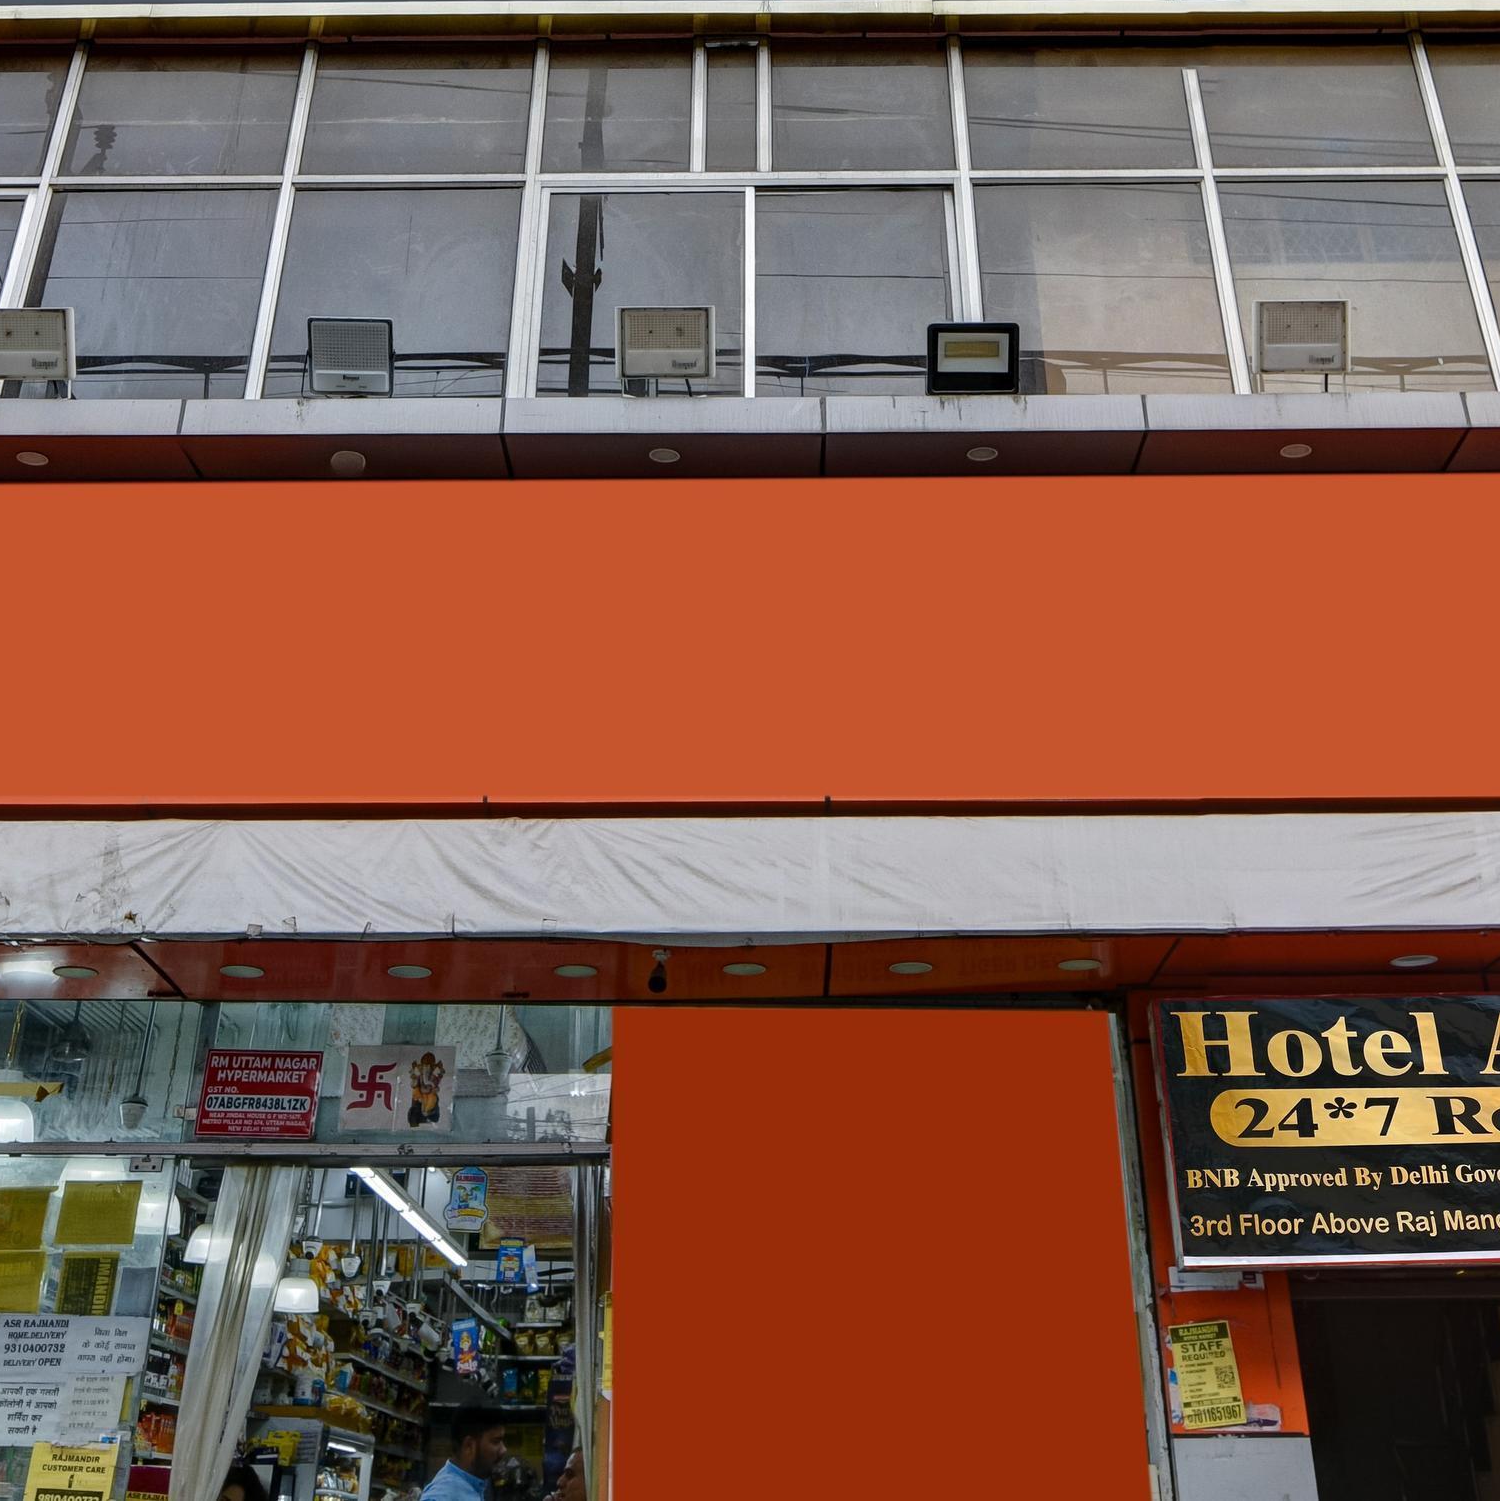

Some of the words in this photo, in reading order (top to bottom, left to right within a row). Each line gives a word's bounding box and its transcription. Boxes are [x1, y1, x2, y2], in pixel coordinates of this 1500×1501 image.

[1170, 1011, 1450, 1078] Hotel
[211, 1056, 229, 1068] RM
[232, 1056, 271, 1069] UTTAM
[274, 1057, 317, 1070] NAGAR
[217, 1070, 308, 1084] HYPERMARKET
[224, 1086, 240, 1094] NO.
[1186, 1168, 1241, 1189] BNB
[1247, 1166, 1348, 1192] Approved
[1354, 1166, 1384, 1191] By
[1389, 1163, 1449, 1186] Delhi
[1190, 1214, 1232, 1237] 3rd
[1239, 1212, 1304, 1236] Floor
[1311, 1211, 1390, 1235] Above
[1396, 1210, 1438, 1237] Raj
[3, 1319, 22, 1329] ASR
[1180, 1340, 1224, 1354] STAFF
[3, 1358, 37, 1367] DELIVERY
[37, 1357, 62, 1367] OPEN
[51, 1453, 101, 1464] RAJMANDIR
[42, 1464, 84, 1473] CUSTOMER
[85, 1465, 107, 1474] CARE
